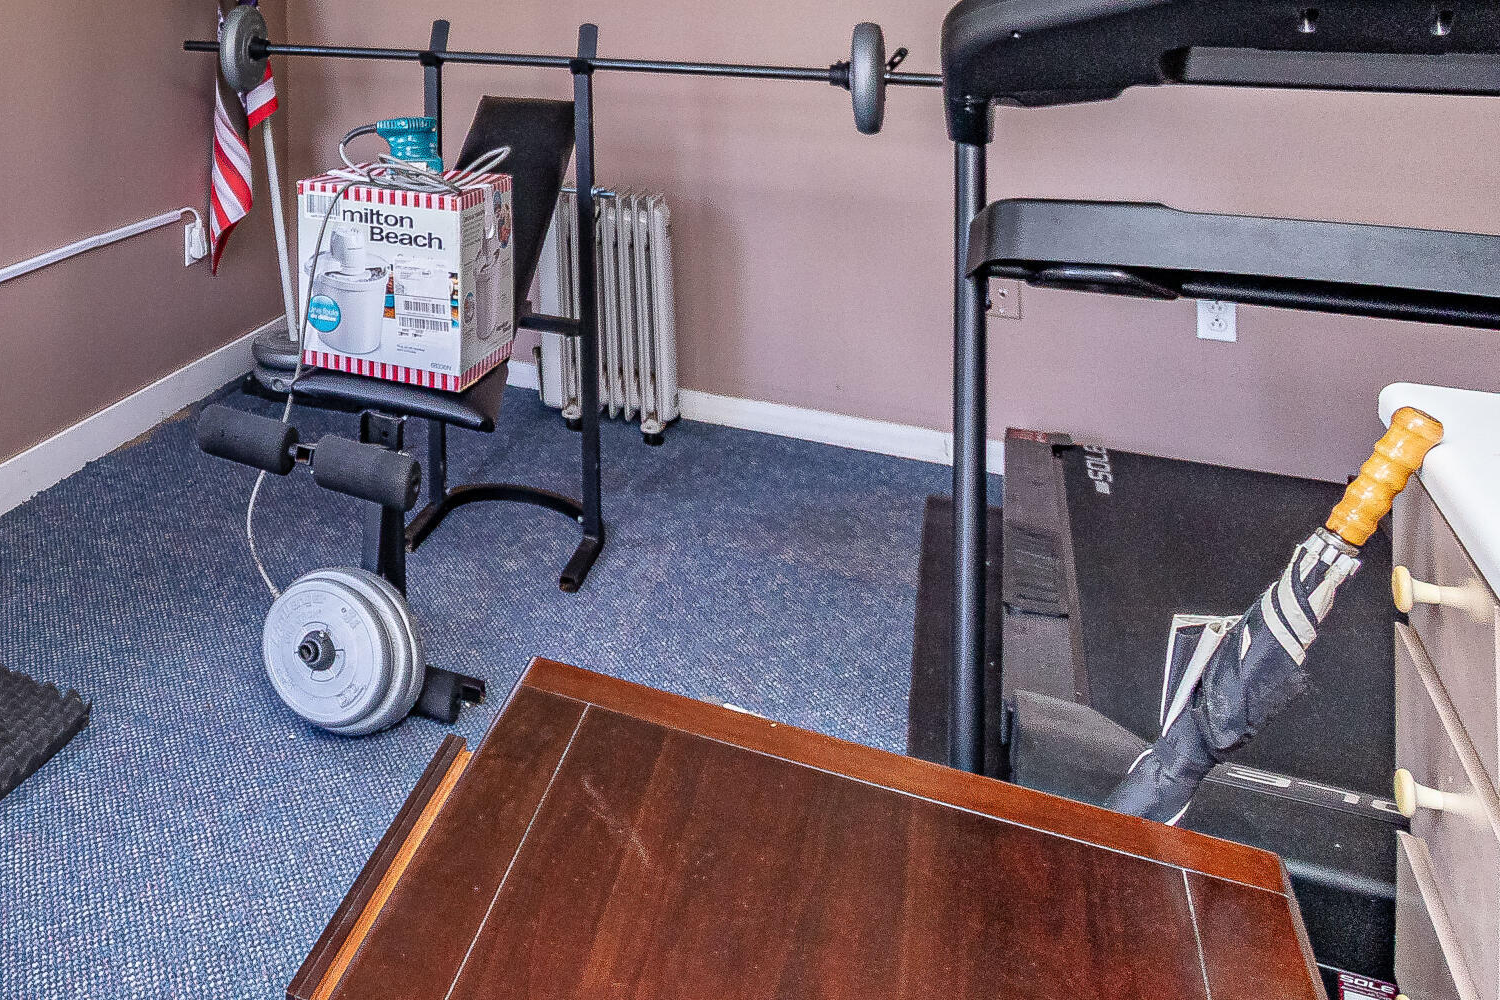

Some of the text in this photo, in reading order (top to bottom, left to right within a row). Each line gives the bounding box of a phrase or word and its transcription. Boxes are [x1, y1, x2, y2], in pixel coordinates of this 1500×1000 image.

[342, 208, 413, 229] milton
[369, 226, 443, 250] Beach
[1340, 974, 1396, 994] SOLE
